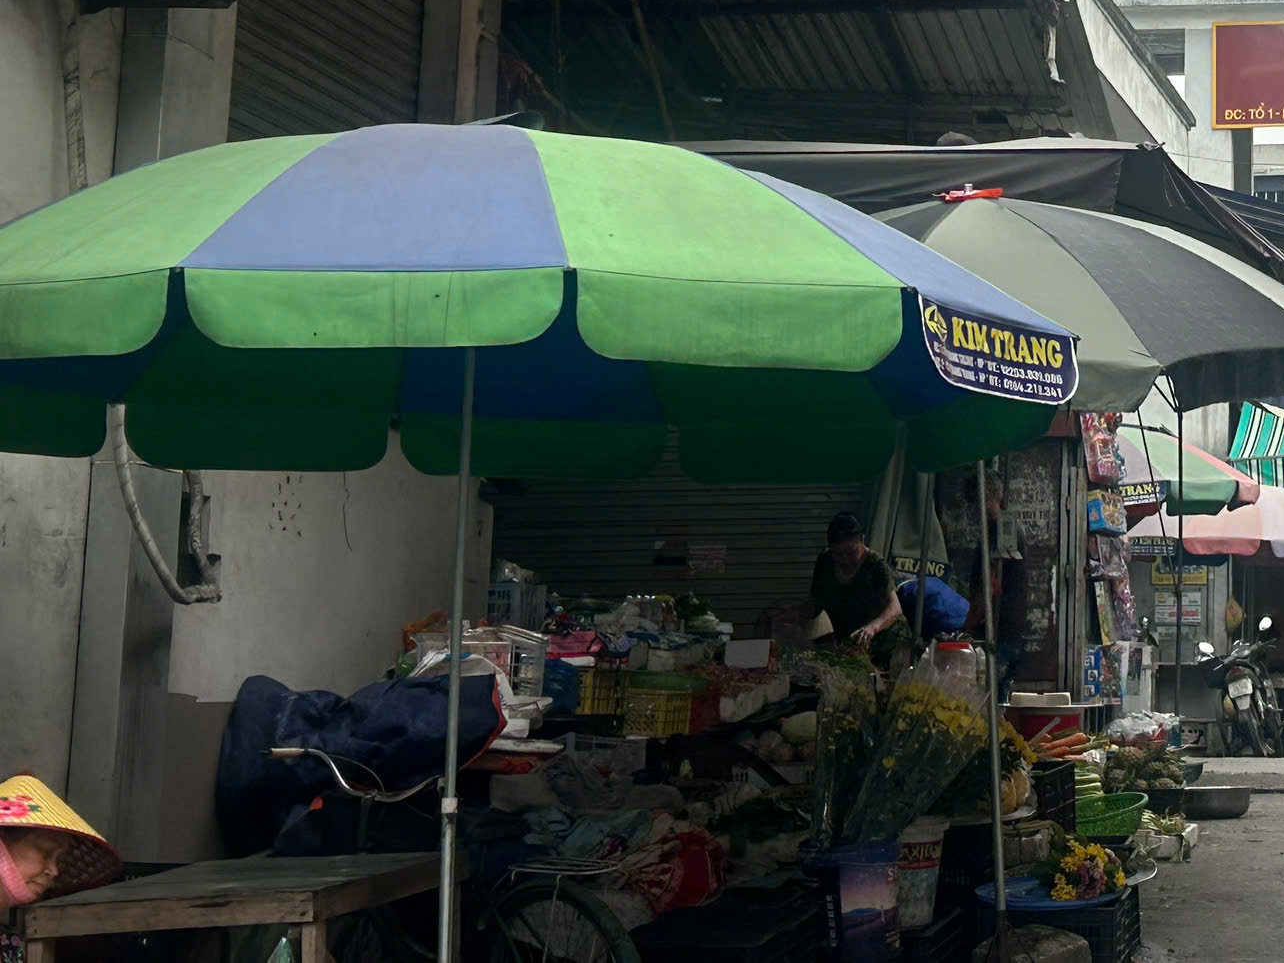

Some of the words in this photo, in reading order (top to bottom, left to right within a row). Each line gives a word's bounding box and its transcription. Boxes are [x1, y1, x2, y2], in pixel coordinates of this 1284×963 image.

[1225, 109, 1246, 120] ĐC:
[1249, 102, 1265, 119] TỔ
[951, 316, 990, 355] KIM
[991, 328, 1064, 369] TRANG
